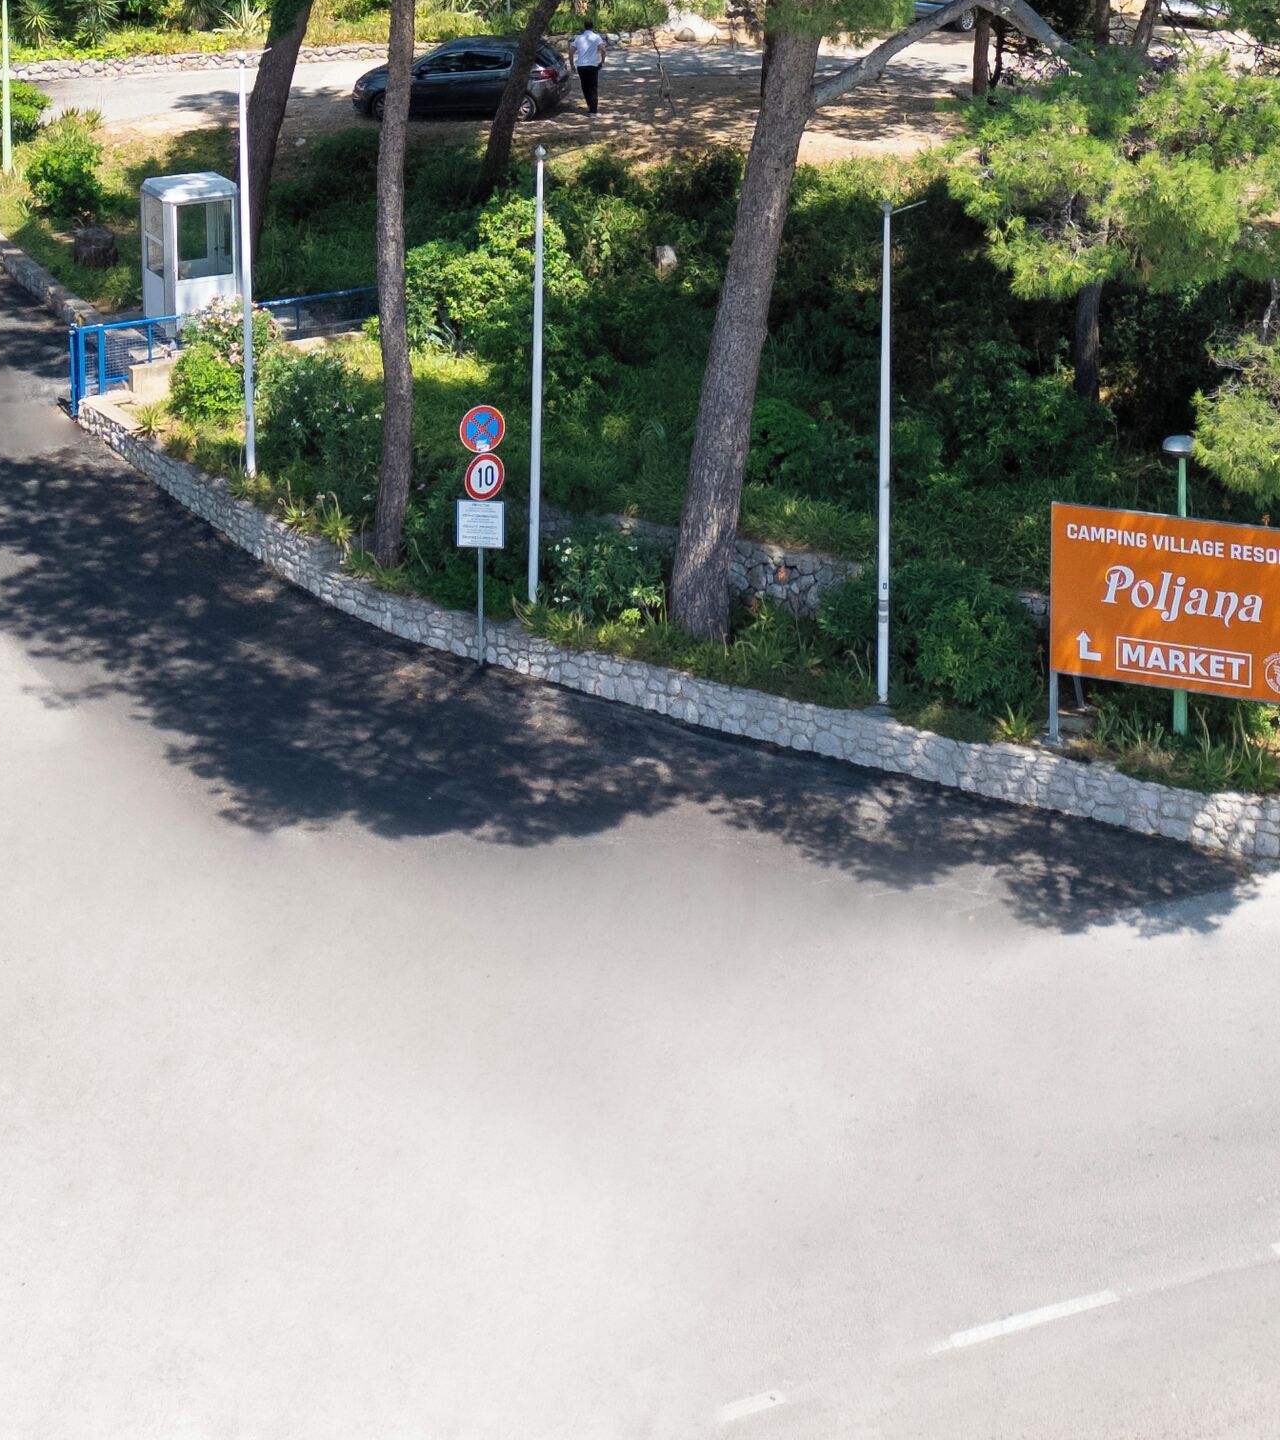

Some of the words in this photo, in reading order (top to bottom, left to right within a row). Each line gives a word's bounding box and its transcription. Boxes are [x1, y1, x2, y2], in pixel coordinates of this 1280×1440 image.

[478, 465, 494, 488] 10
[1066, 523, 1148, 548] CAMPING
[1152, 534, 1225, 558] VILLAGE
[1100, 565, 1263, 628] Poljana
[1122, 643, 1246, 680] MARKET
